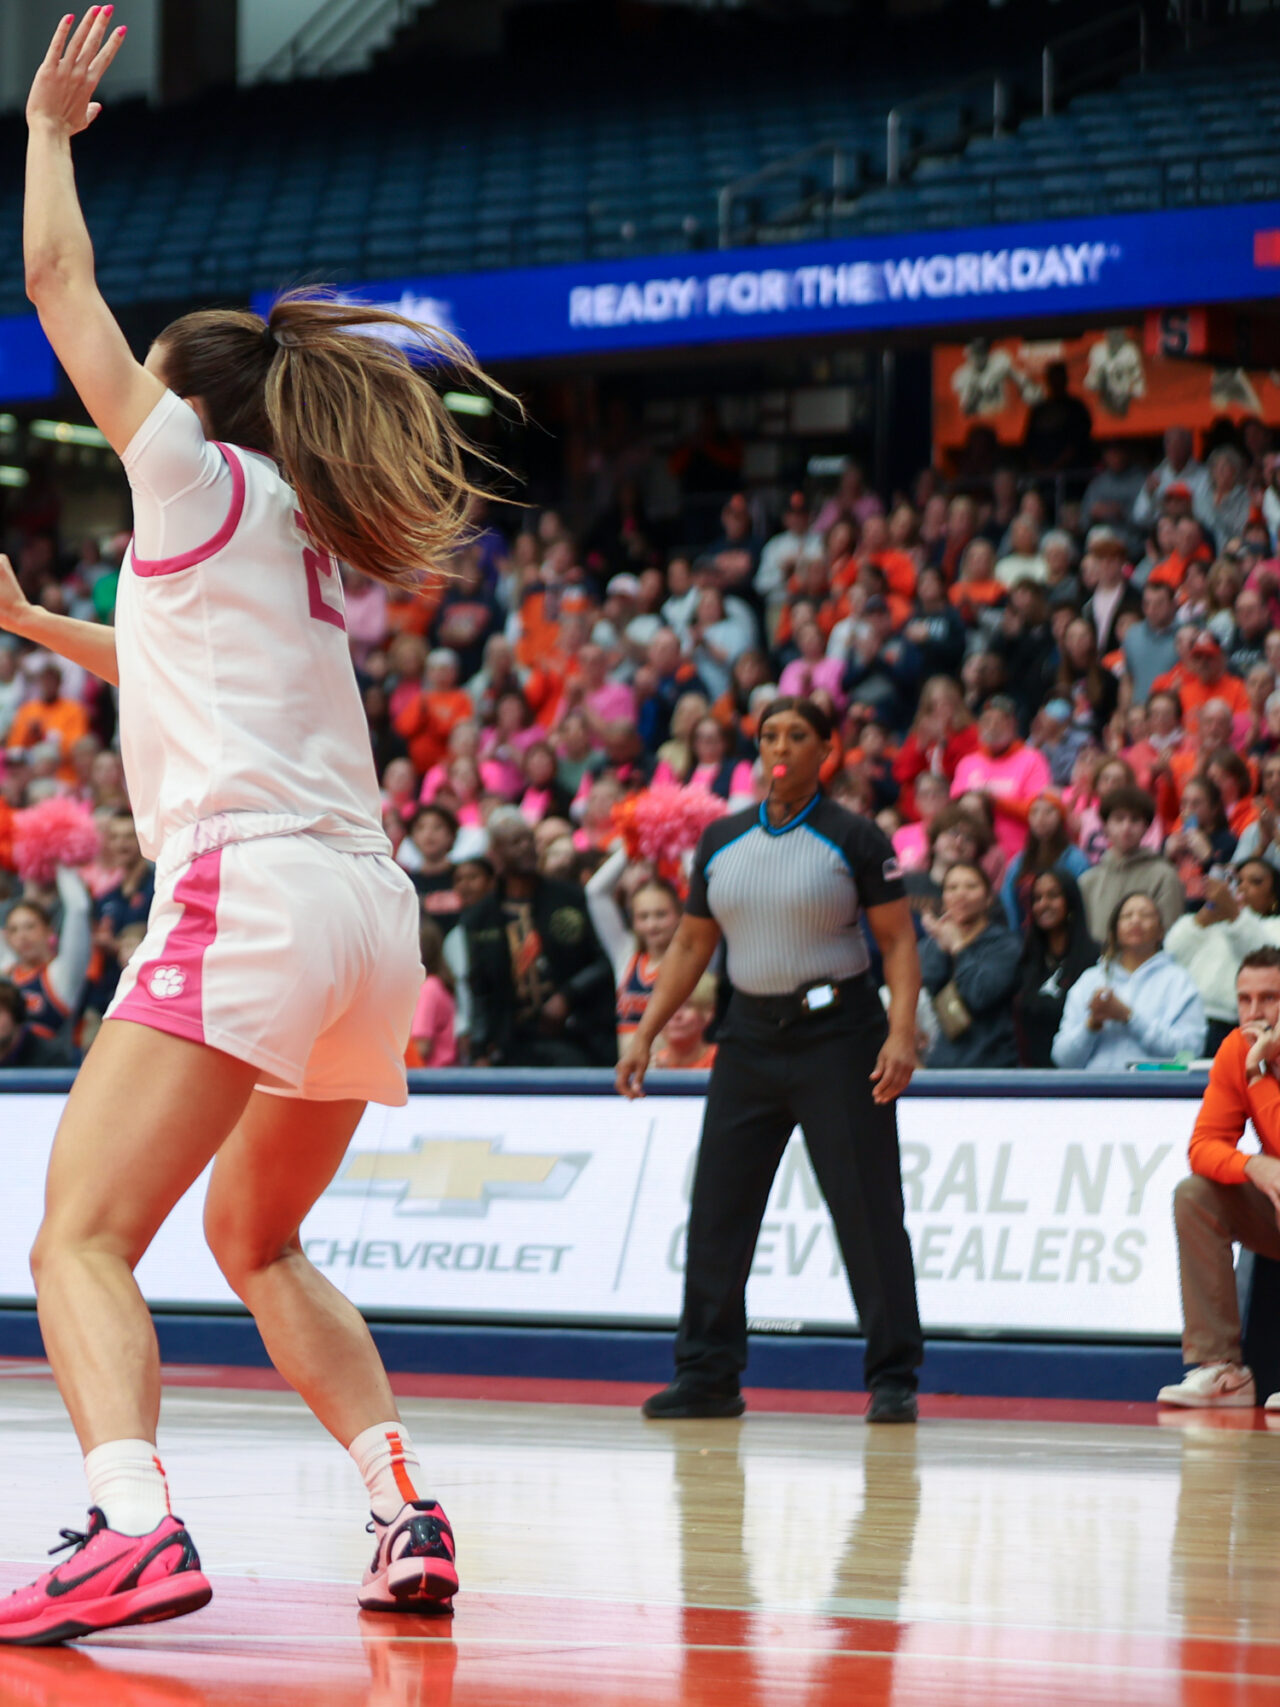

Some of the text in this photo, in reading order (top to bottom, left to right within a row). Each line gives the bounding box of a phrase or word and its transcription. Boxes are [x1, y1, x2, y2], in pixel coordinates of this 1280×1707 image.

[570, 276, 693, 328] READY
[706, 269, 787, 315] FOR
[798, 261, 875, 307] THE
[1054, 1143, 1173, 1216] NY
[304, 1239, 573, 1274] CHEVROLET
[915, 1226, 1147, 1284] EALERS
